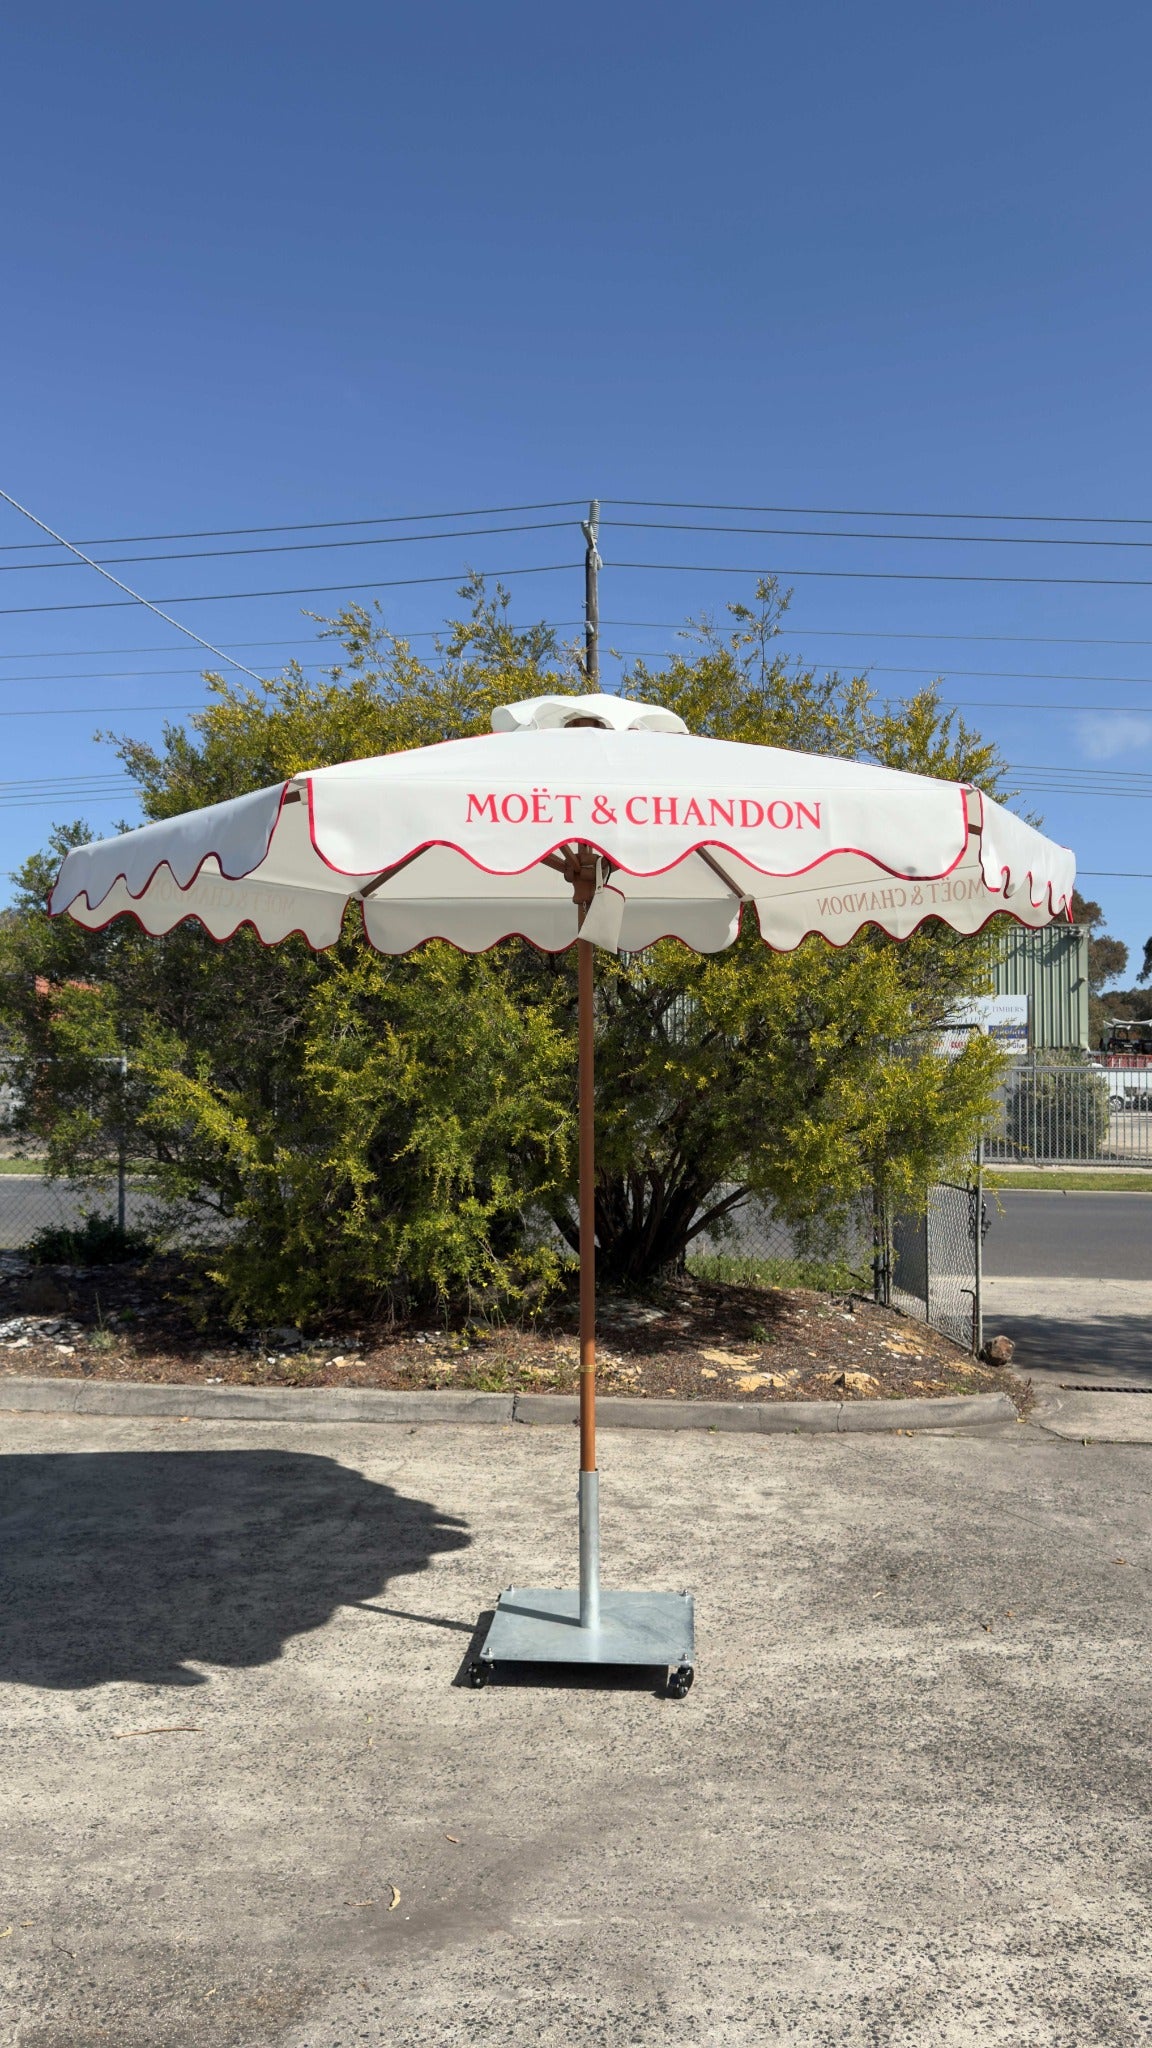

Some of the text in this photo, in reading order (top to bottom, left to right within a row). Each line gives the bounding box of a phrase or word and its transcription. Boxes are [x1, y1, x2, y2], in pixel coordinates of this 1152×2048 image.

[465, 788, 822, 830] MOËT & CHANDON
